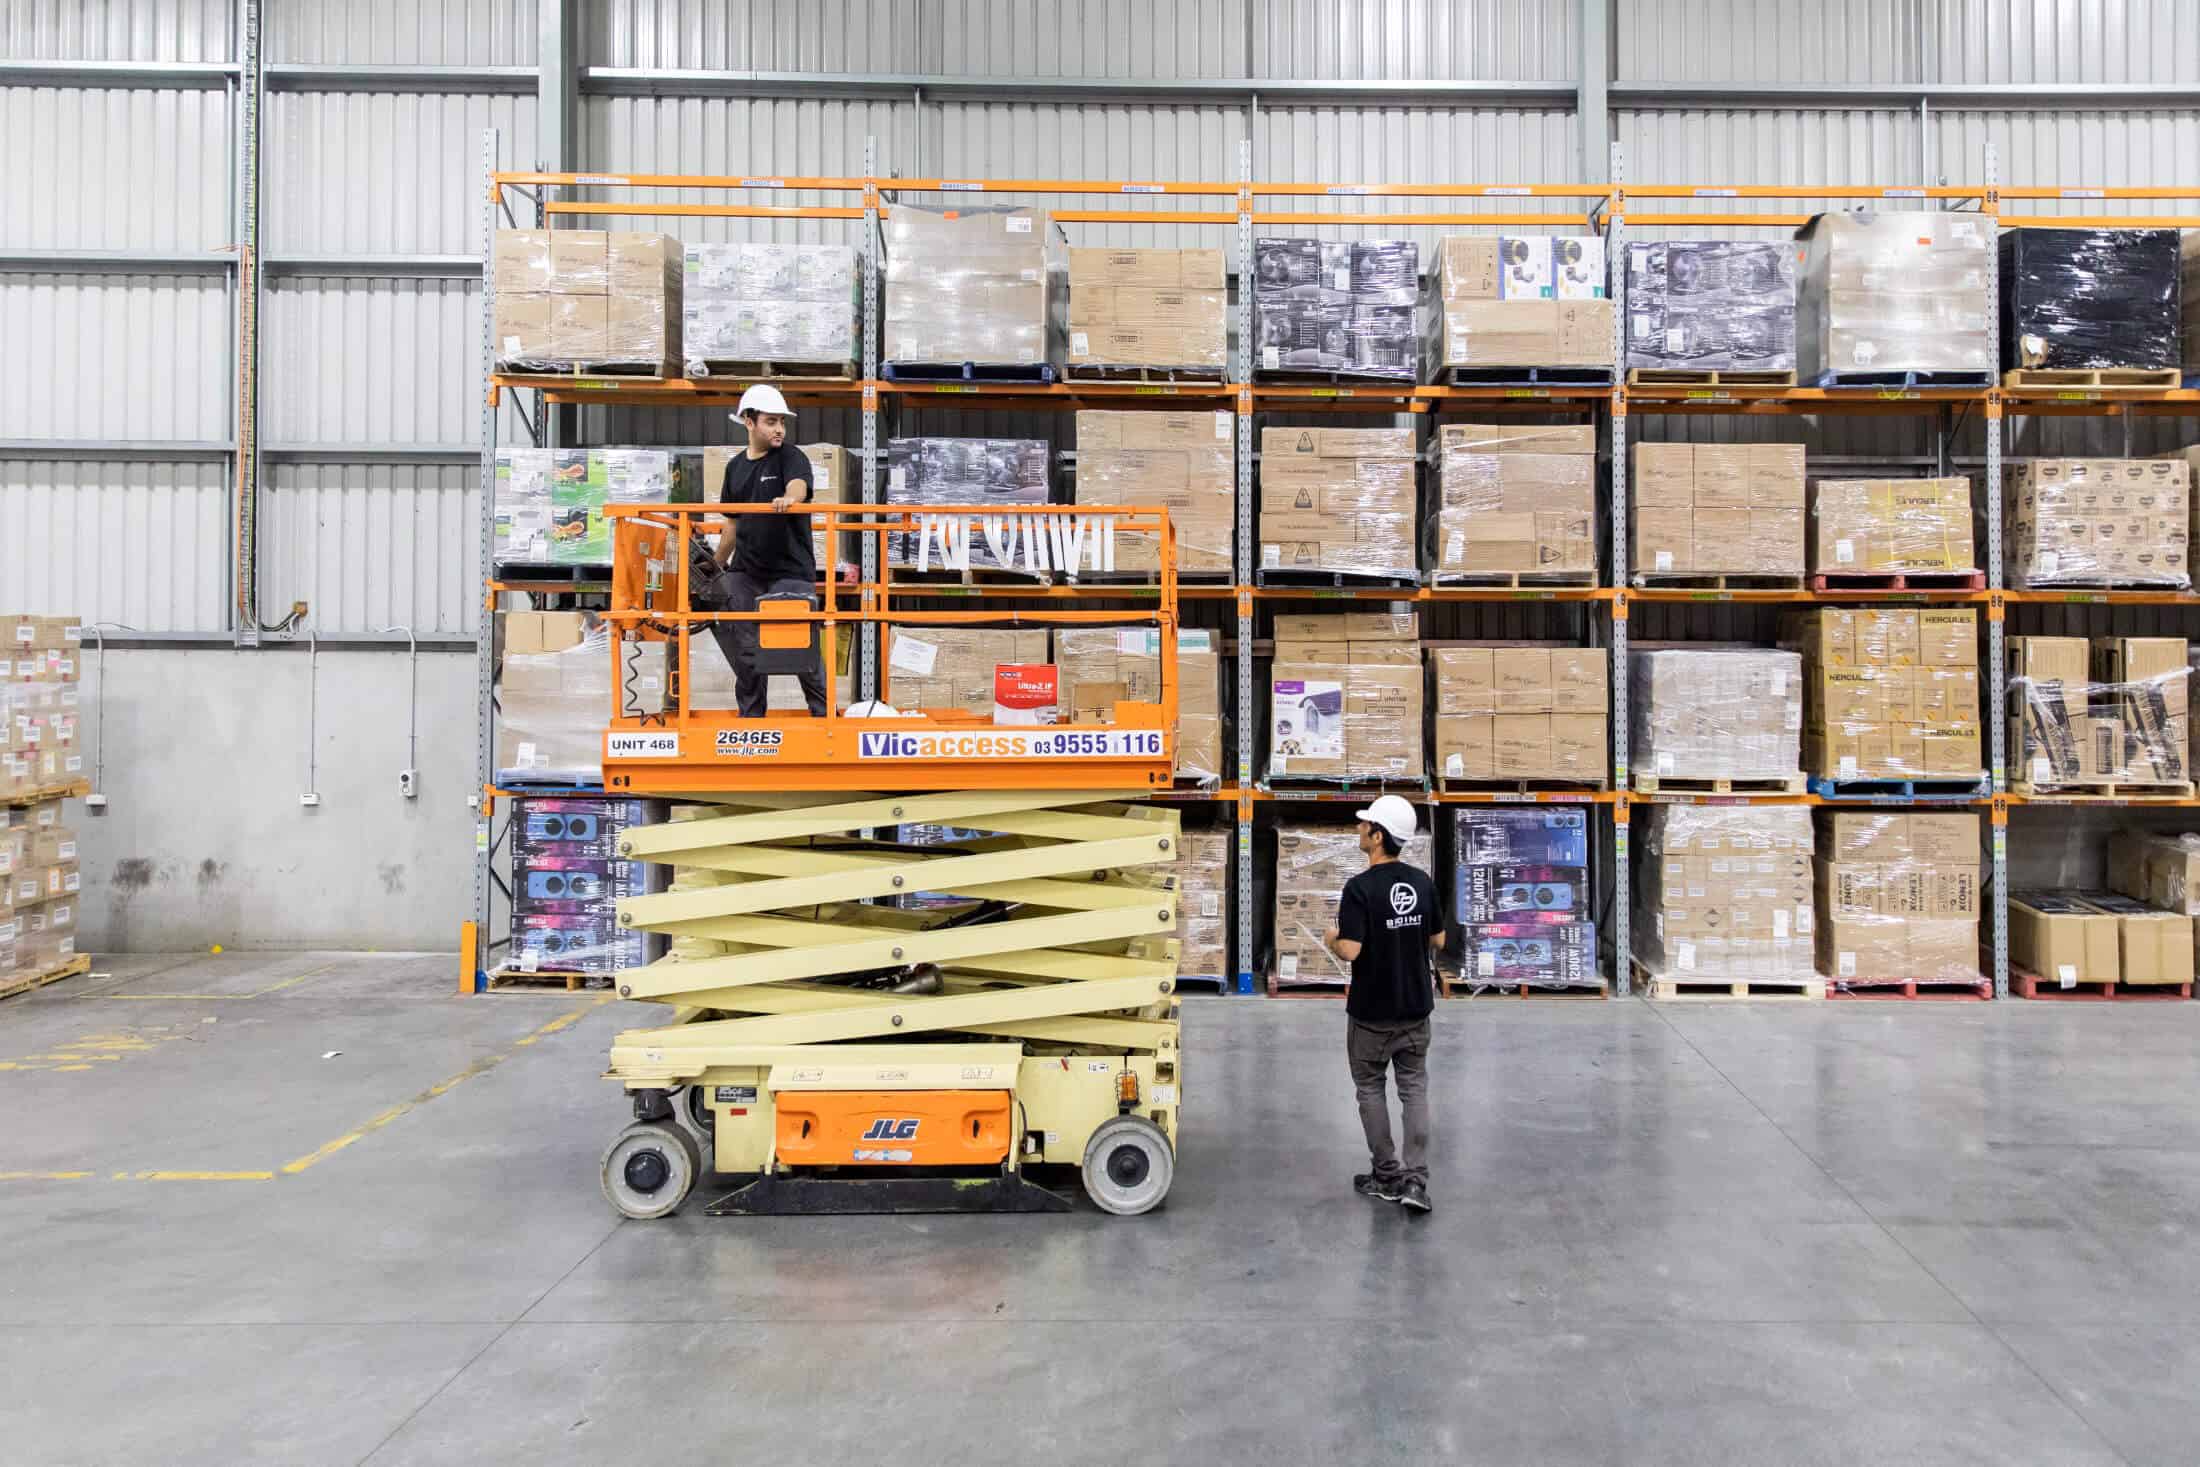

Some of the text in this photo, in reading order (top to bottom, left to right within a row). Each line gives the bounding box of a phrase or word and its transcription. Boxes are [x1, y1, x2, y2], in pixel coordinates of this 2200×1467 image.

[717, 731, 781, 744] 2646ES
[612, 739, 675, 750] UNIT 468
[717, 746, 778, 756] www.jlg.com
[862, 733, 1027, 756] Vicaccess
[1034, 741, 1051, 754] 03
[1054, 734, 1107, 754] 9555
[863, 1119, 919, 1140] JLG
